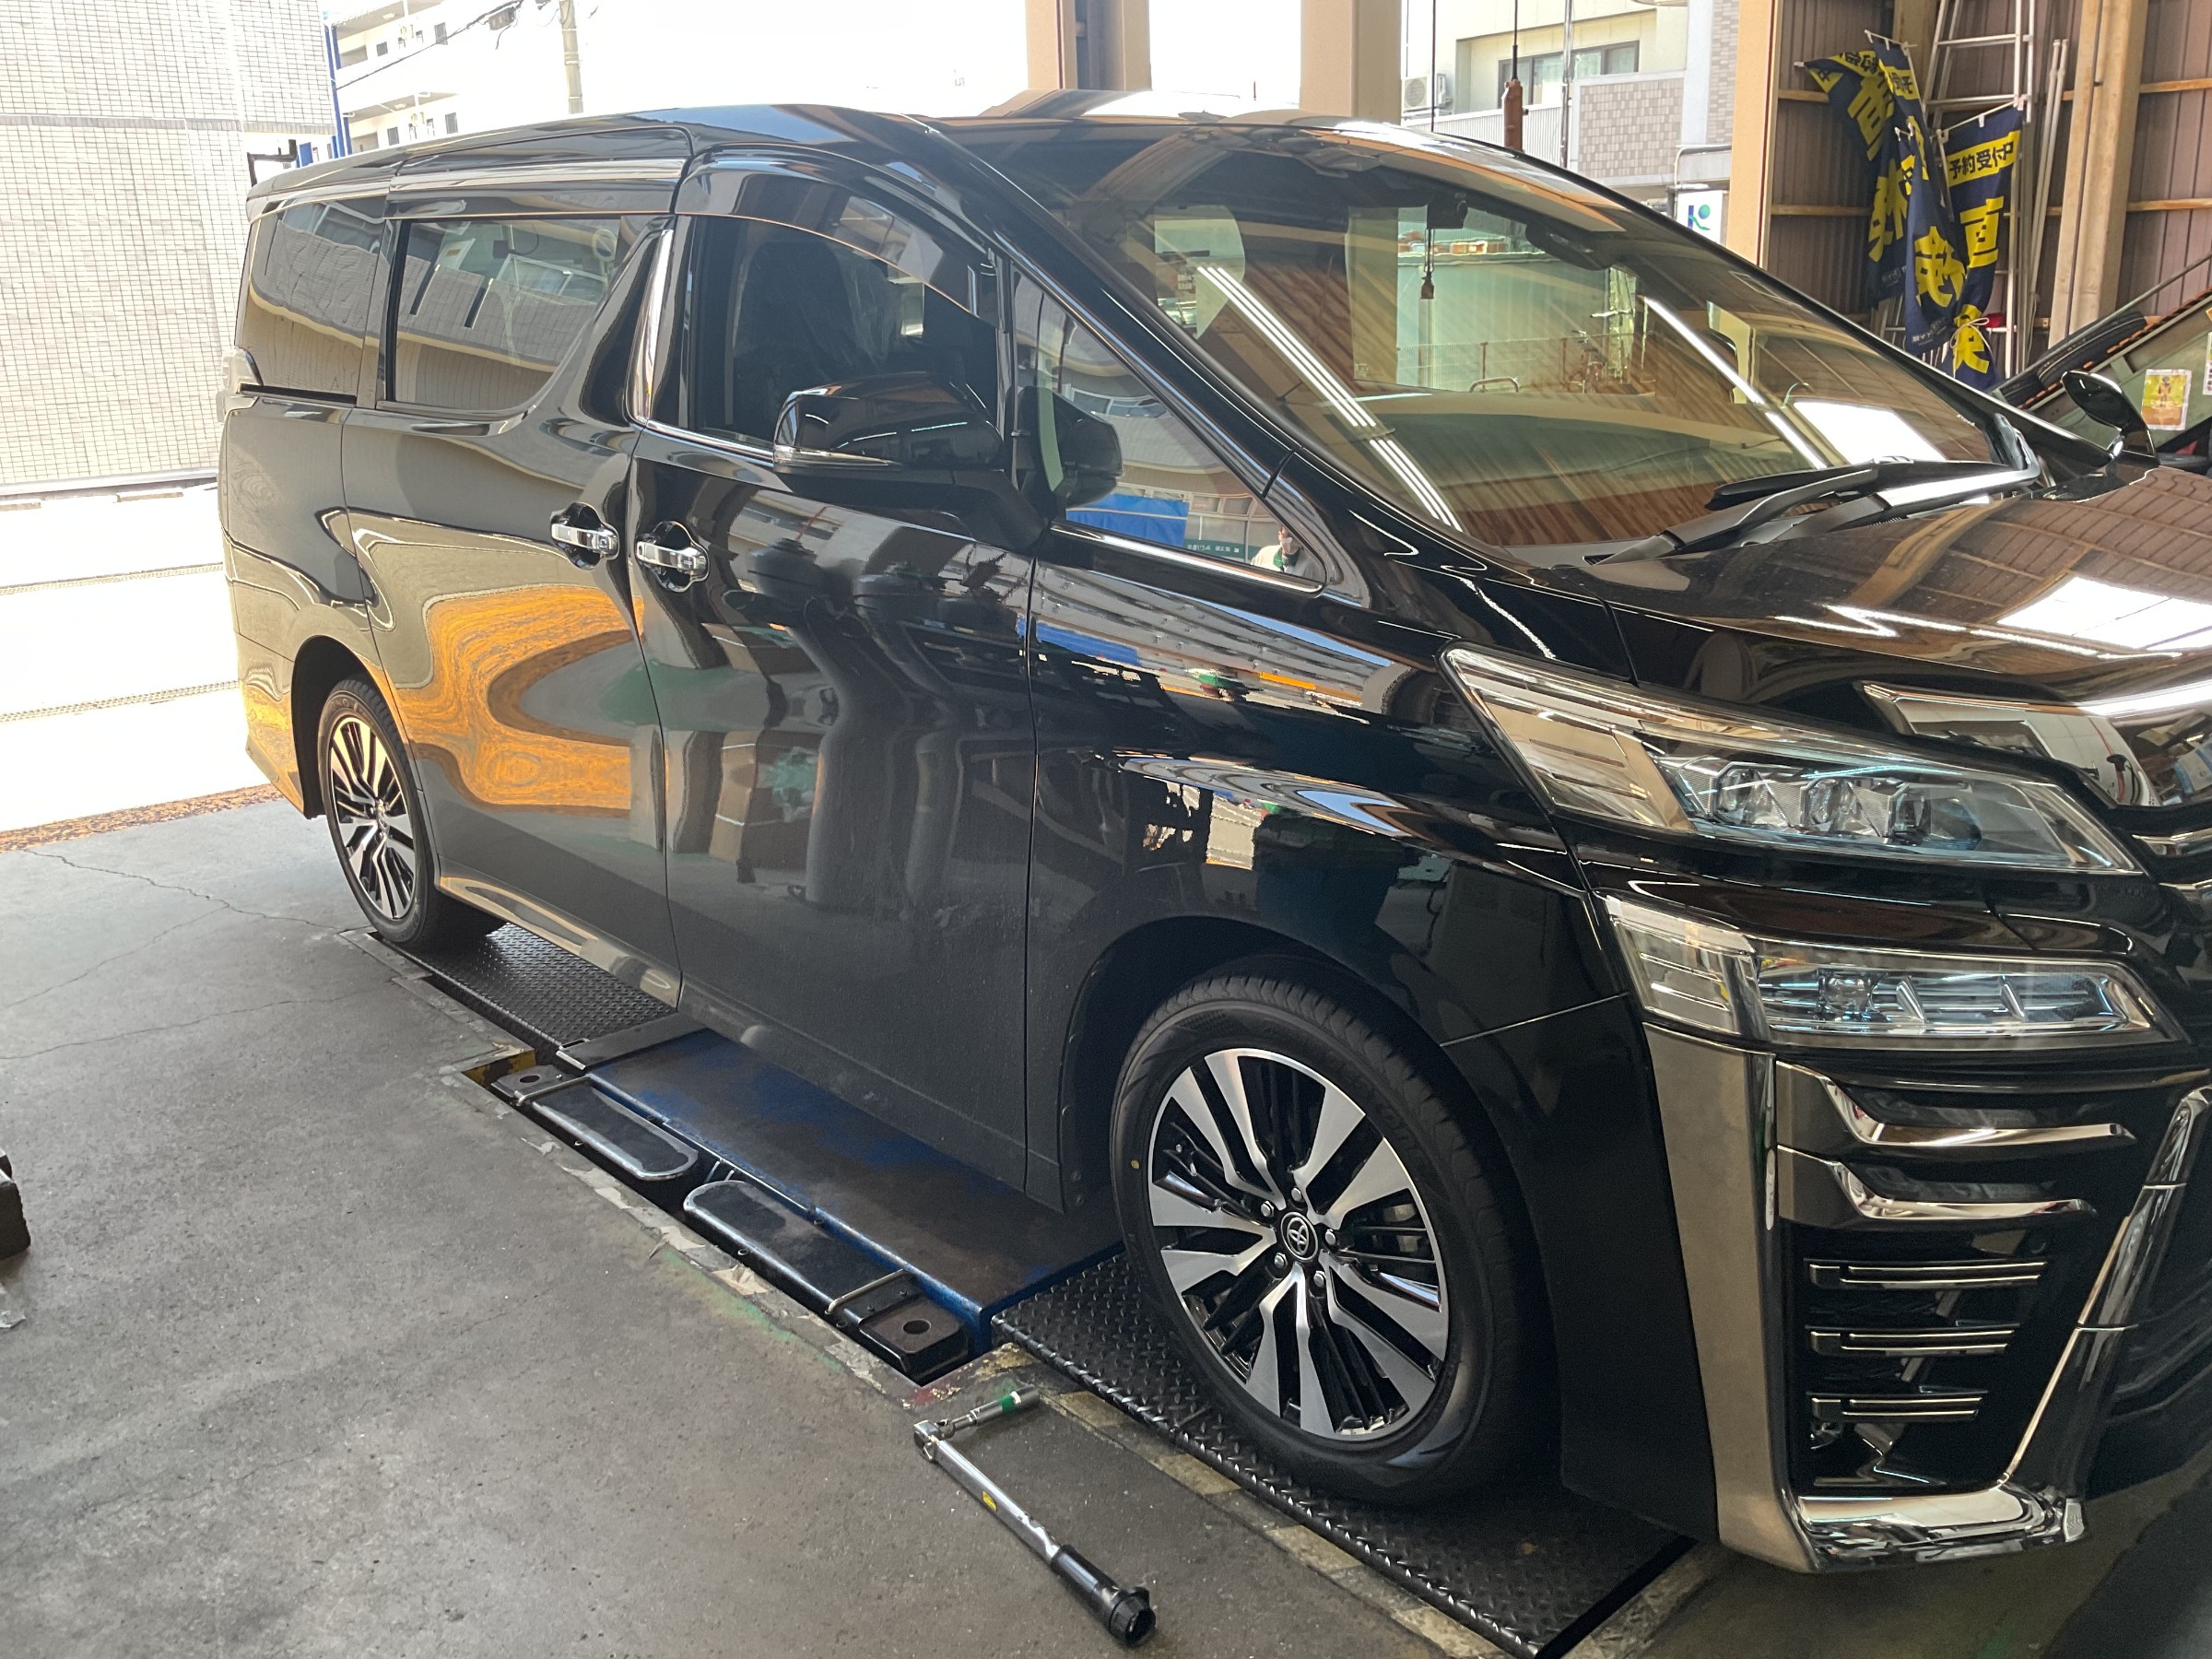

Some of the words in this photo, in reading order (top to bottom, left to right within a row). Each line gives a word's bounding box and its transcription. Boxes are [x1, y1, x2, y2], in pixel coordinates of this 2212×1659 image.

[1949, 141, 2013, 180] 予約受付中
